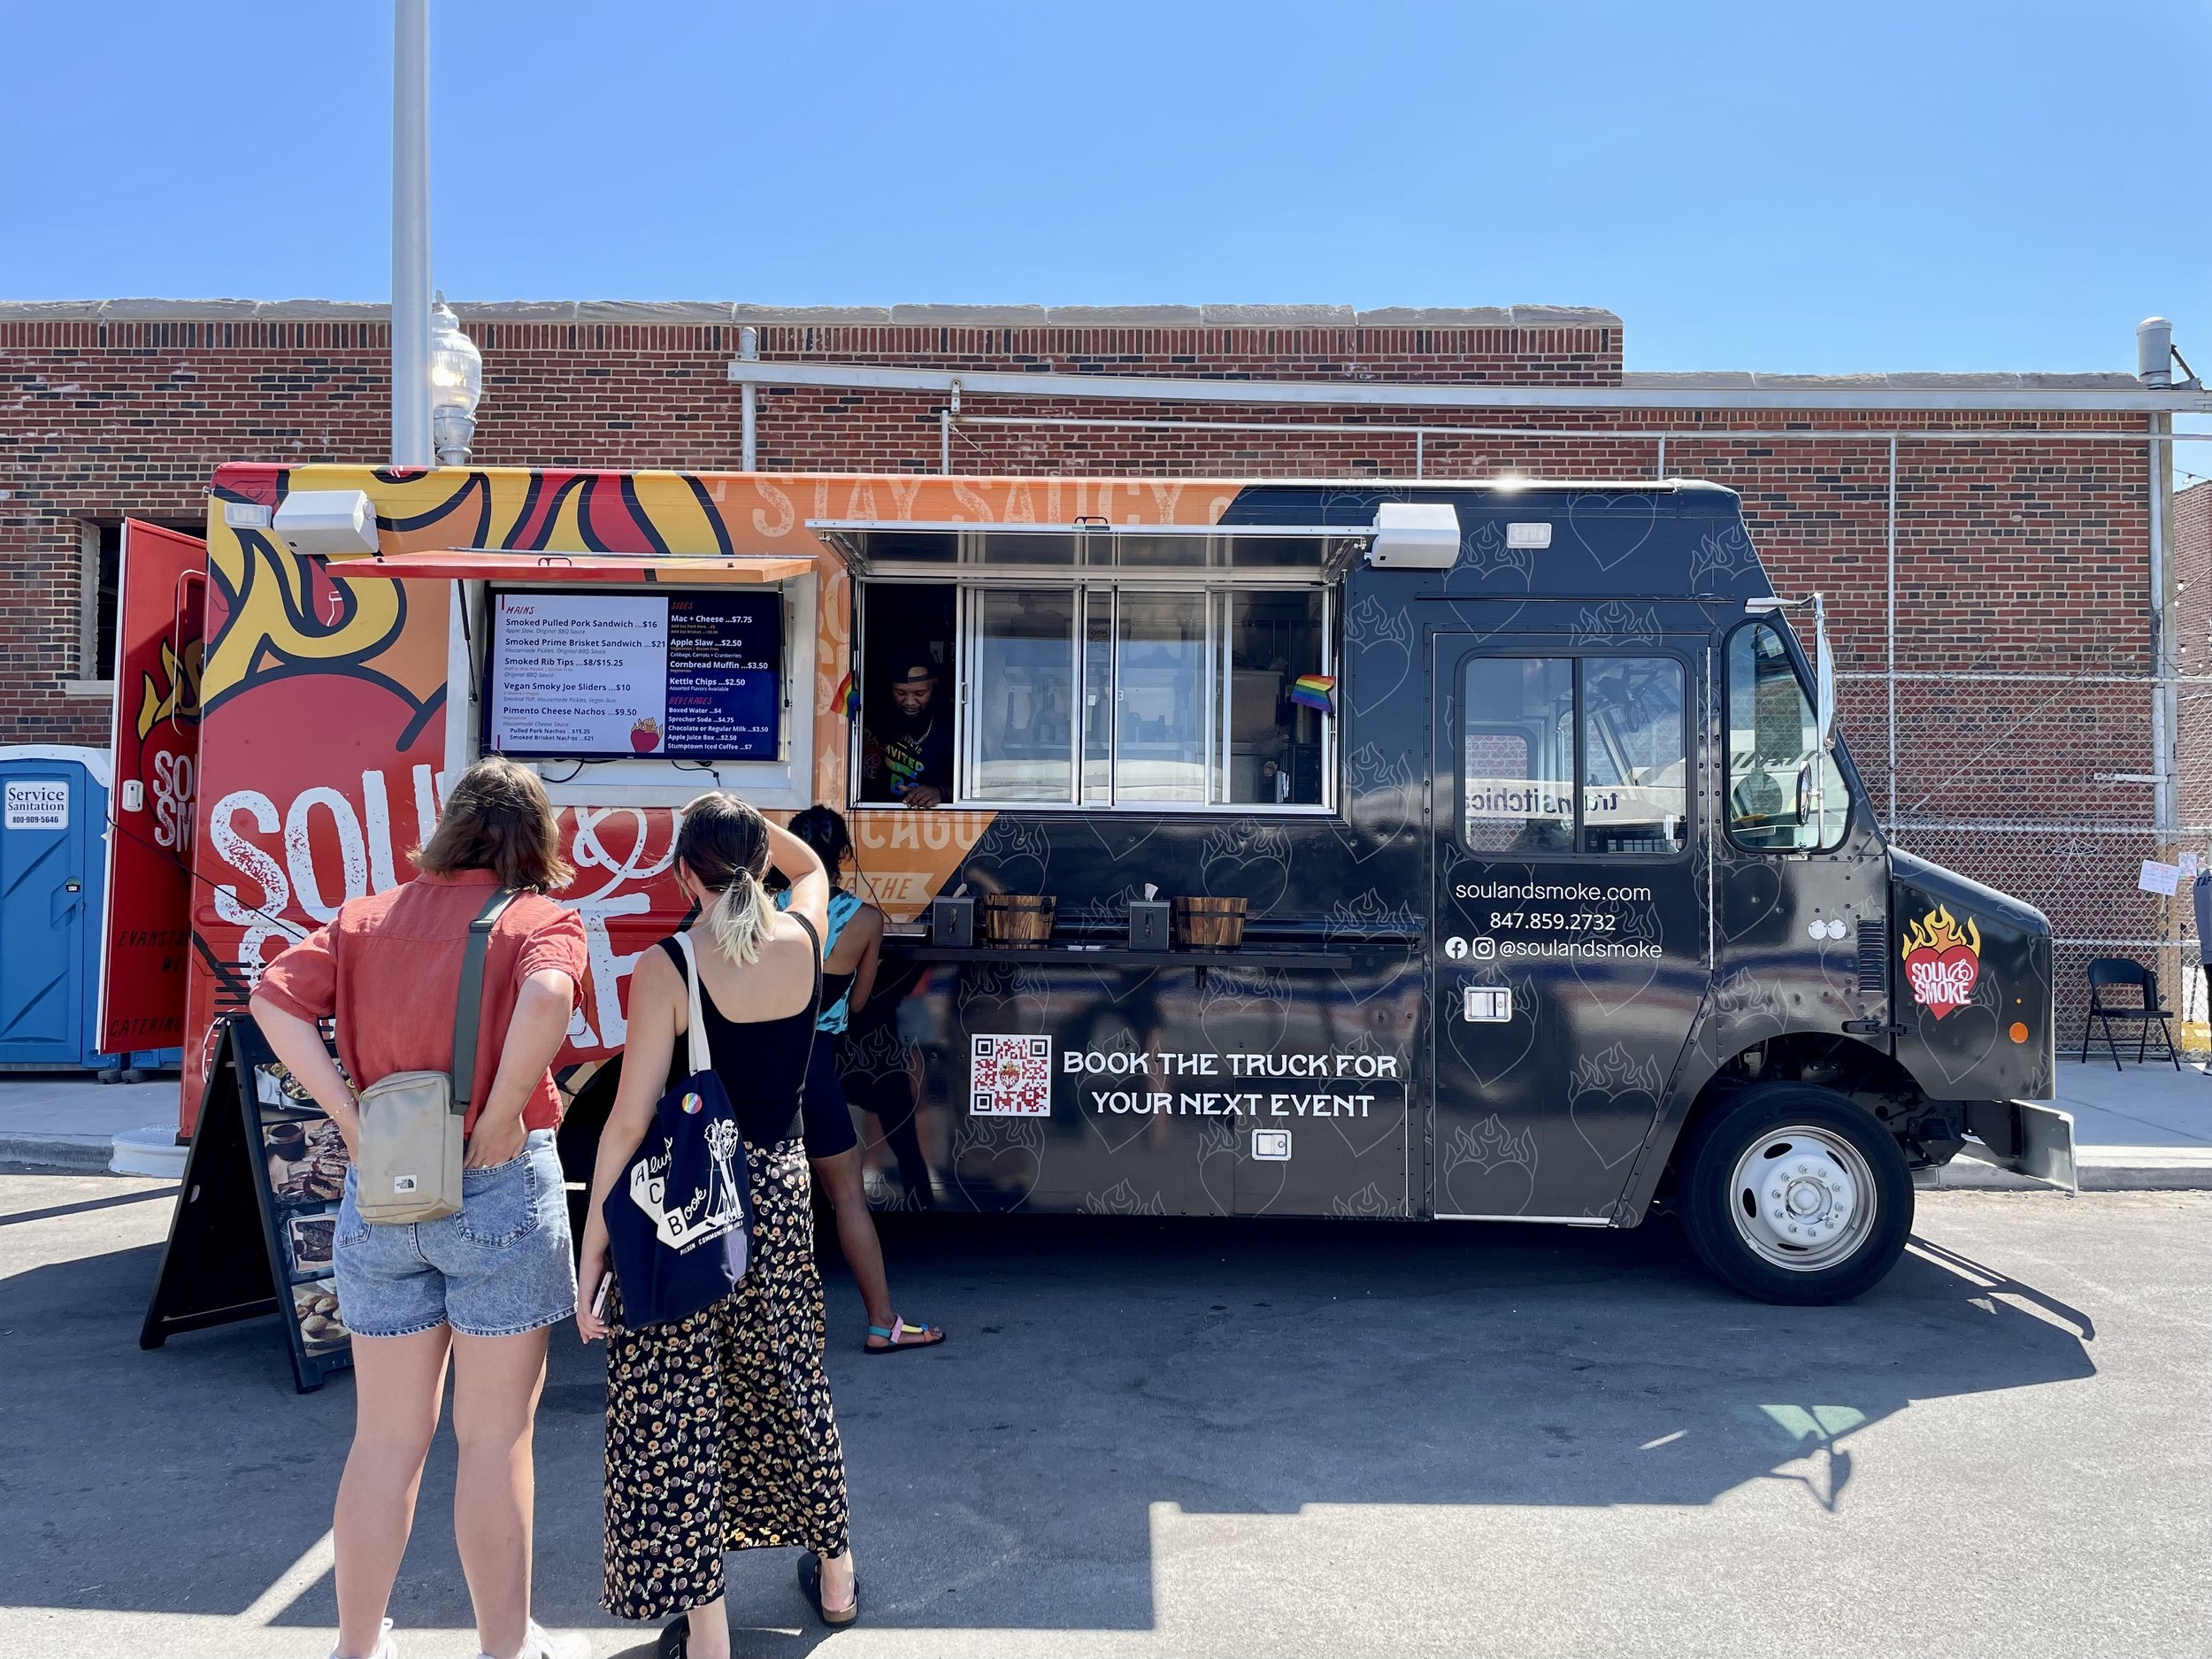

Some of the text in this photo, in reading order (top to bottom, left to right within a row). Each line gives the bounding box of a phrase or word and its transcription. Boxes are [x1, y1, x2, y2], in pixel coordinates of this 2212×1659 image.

[504, 682, 530, 691] Vegan
[9, 787, 65, 801] Service
[8, 802, 64, 810] Sanitation
[210, 764, 444, 926] SOU
[867, 877, 914, 900] THE
[1455, 882, 1651, 902] soulandsmoke.com
[1490, 912, 1616, 930] 847.859.2732
[1500, 939, 1662, 958] @soulandsmoke
[1911, 962, 1950, 983] SOUL
[1914, 981, 1971, 1004] SMOKE
[1063, 1050, 1398, 1078] BOOK THE TRUCK FOR
[1091, 1092, 1375, 1118] YOUR NEXT EVENT
[668, 1187, 706, 1237] Book
